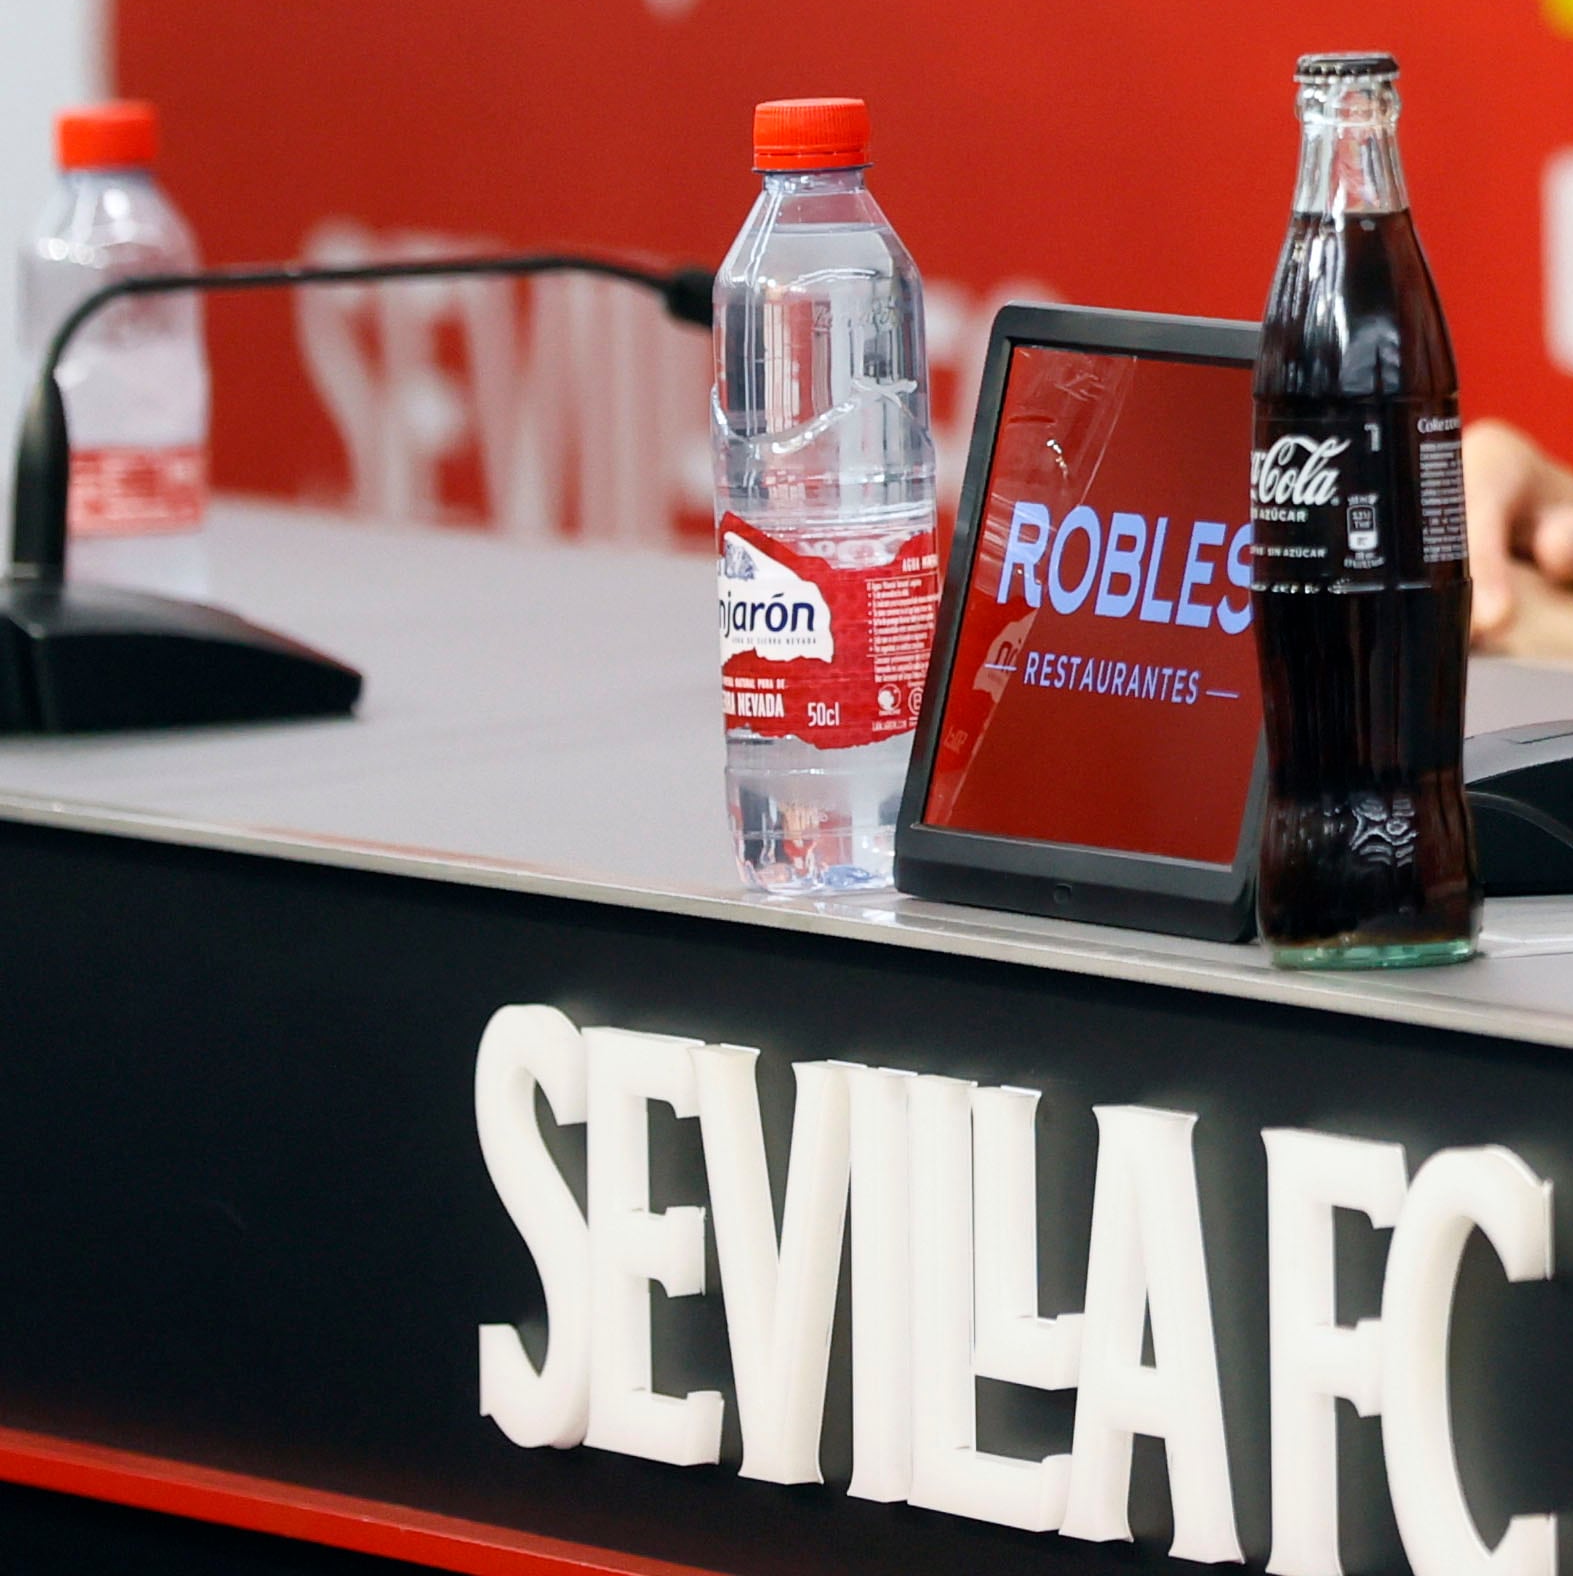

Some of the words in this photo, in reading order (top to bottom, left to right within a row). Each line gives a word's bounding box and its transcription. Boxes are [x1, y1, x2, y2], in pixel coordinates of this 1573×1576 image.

[997, 500, 1254, 636] ROBLES
[719, 590, 815, 638] njarón
[1023, 651, 1201, 705] RESTAURANTES
[737, 692, 785, 718] NEVADA
[807, 701, 840, 727] 50cl
[474, 1002, 1246, 1566] SEVILLA
[1261, 1126, 1557, 1576] FC
